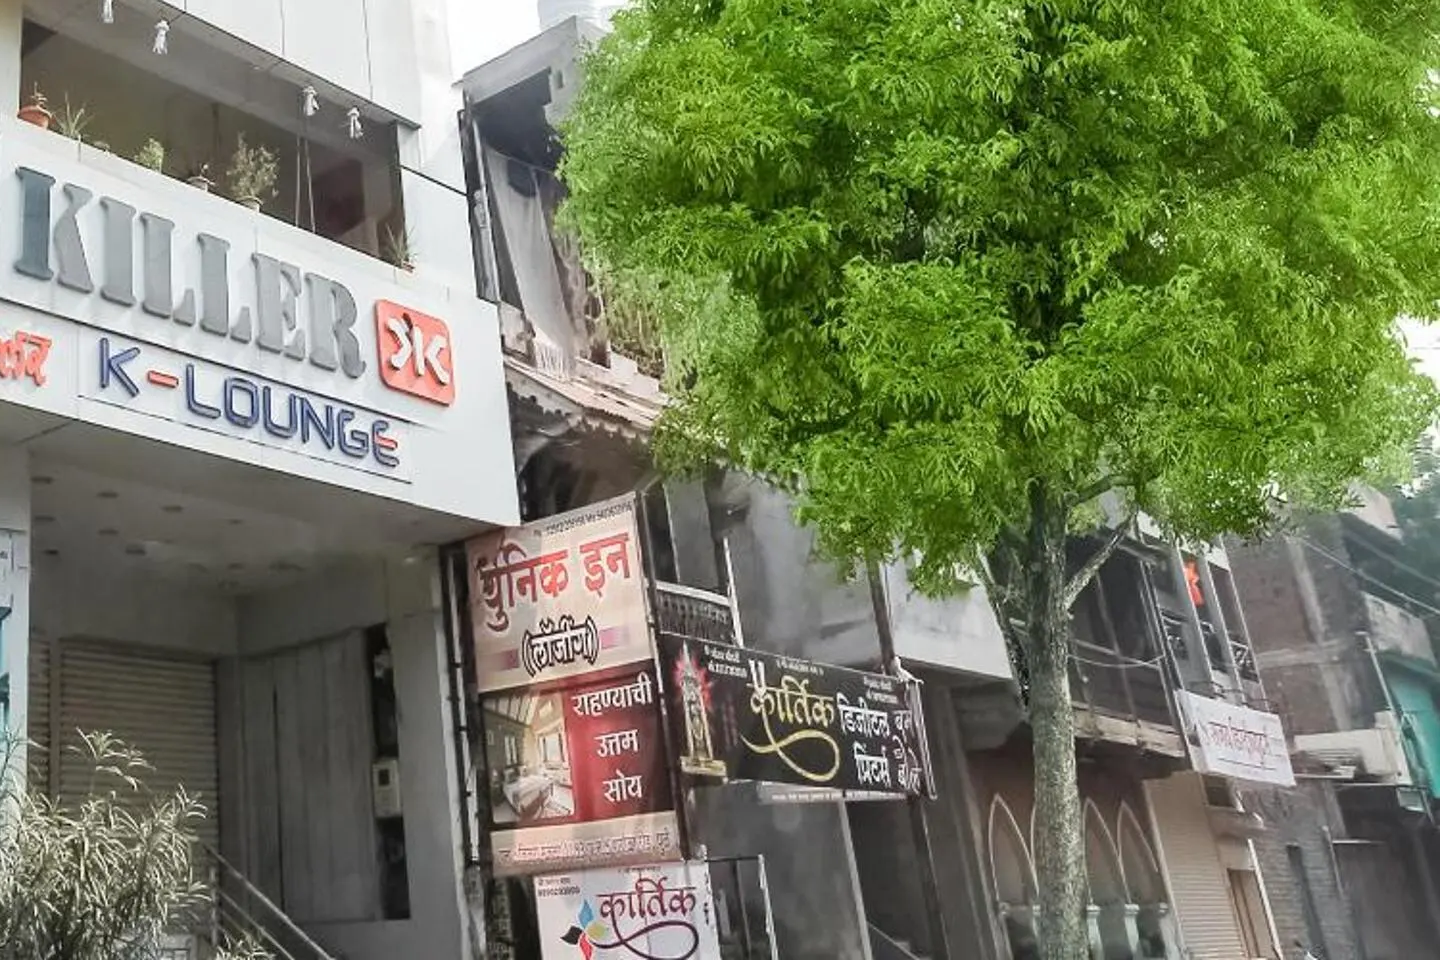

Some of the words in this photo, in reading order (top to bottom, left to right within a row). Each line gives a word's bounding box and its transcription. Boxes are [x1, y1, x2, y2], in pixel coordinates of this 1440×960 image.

[13, 166, 367, 379] KILLER
[476, 539, 570, 633] युनिक
[579, 532, 631, 598] इन
[570, 671, 654, 717] राहण्याची
[746, 673, 835, 750] कार्तिक
[594, 728, 640, 758] उत्तम
[602, 769, 643, 803] सोय
[595, 875, 697, 942] कार्तिक
